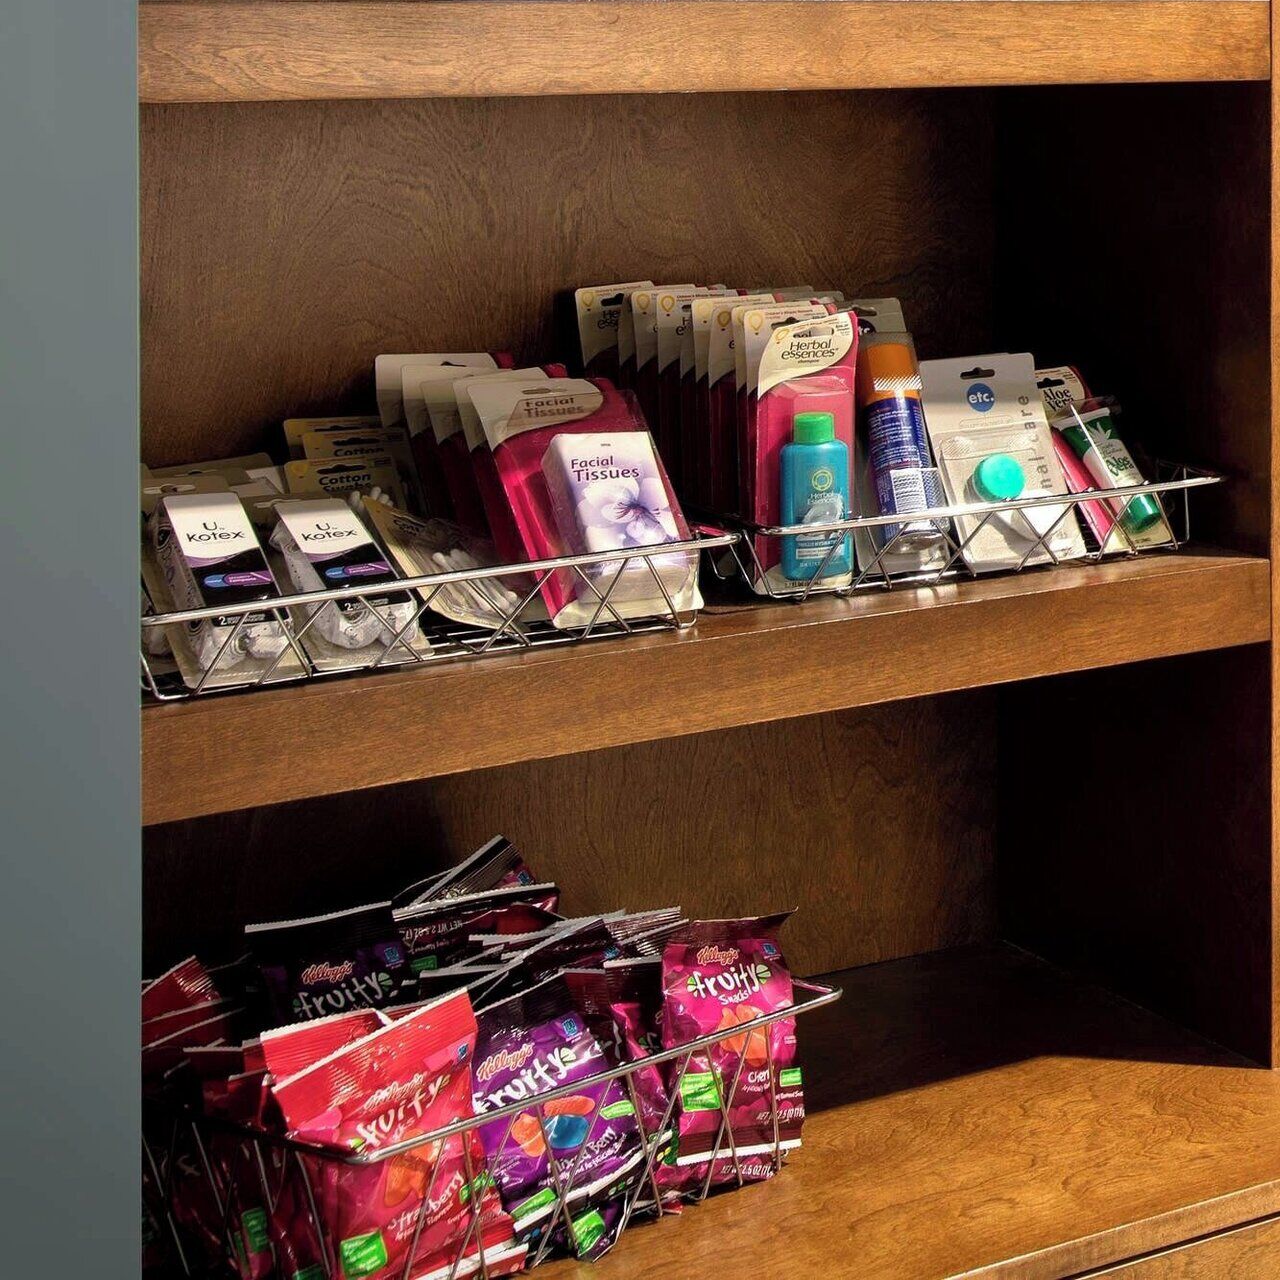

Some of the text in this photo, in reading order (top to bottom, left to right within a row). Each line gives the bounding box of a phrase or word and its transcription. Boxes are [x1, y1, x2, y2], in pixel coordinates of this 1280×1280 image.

[789, 338, 832, 352] Herbal
[780, 348, 838, 361] essences
[525, 396, 575, 408] Facial
[968, 391, 994, 405] etc.
[1042, 388, 1072, 402] Aloe
[1047, 397, 1074, 412] Vera
[524, 405, 585, 419] Tissues
[570, 455, 614, 470] Facial
[318, 473, 371, 486] Cotton
[572, 466, 640, 483] Tissues
[202, 521, 219, 533] U
[315, 521, 332, 533] U
[186, 529, 246, 544] kotex
[301, 528, 358, 542] kotex
[344, 601, 354, 612] 2
[219, 615, 228, 626] 2
[696, 945, 741, 965] Kellogg's
[300, 961, 354, 986] Kellogg's
[695, 964, 753, 999] fruity
[302, 970, 380, 1018] fruity
[476, 1041, 536, 1081] Kellogg's
[473, 1046, 562, 1114] fruity
